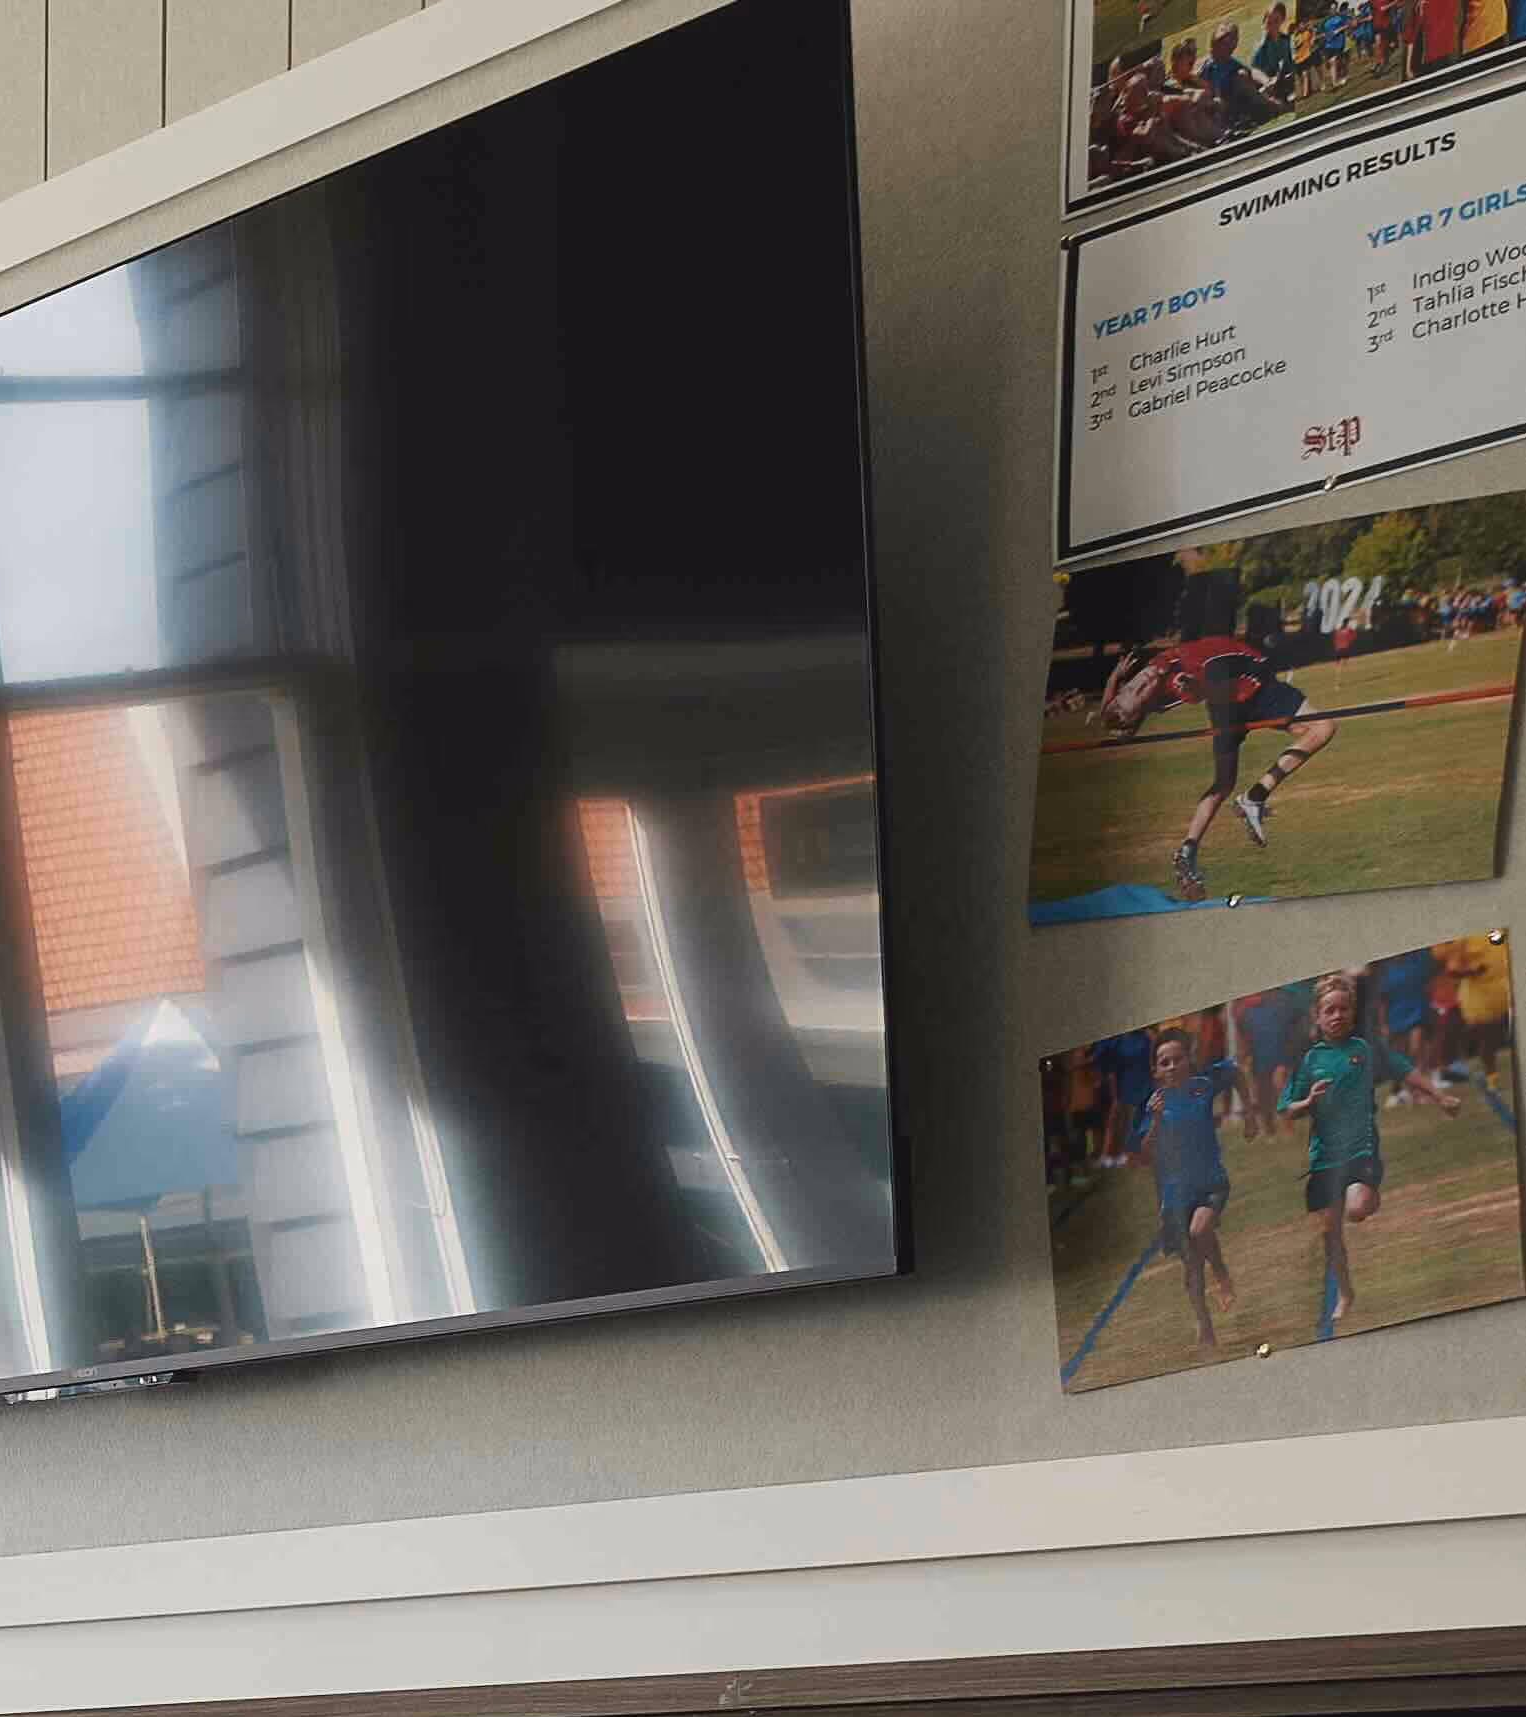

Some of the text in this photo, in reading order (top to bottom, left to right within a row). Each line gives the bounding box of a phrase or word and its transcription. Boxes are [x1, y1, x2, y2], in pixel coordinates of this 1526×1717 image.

[1218, 132, 1457, 227] SWIMMING RESULTS
[1366, 183, 1526, 249] YEAR 7 GIRLS
[1093, 280, 1227, 340] YEAR 7 BOYS
[1366, 282, 1387, 304] 1st
[1412, 258, 1481, 290] Indigo
[1366, 304, 1398, 328] 2nd
[1412, 284, 1475, 314] Tahlia
[1089, 325, 1237, 384] 1st Charlie Hurt
[1366, 329, 1394, 354] 3rd
[1411, 300, 1510, 339] Charlotte
[1088, 359, 1287, 431] 3rd Gabriel Peacocke
[1090, 346, 1246, 409] 2nd Levi Simpson
